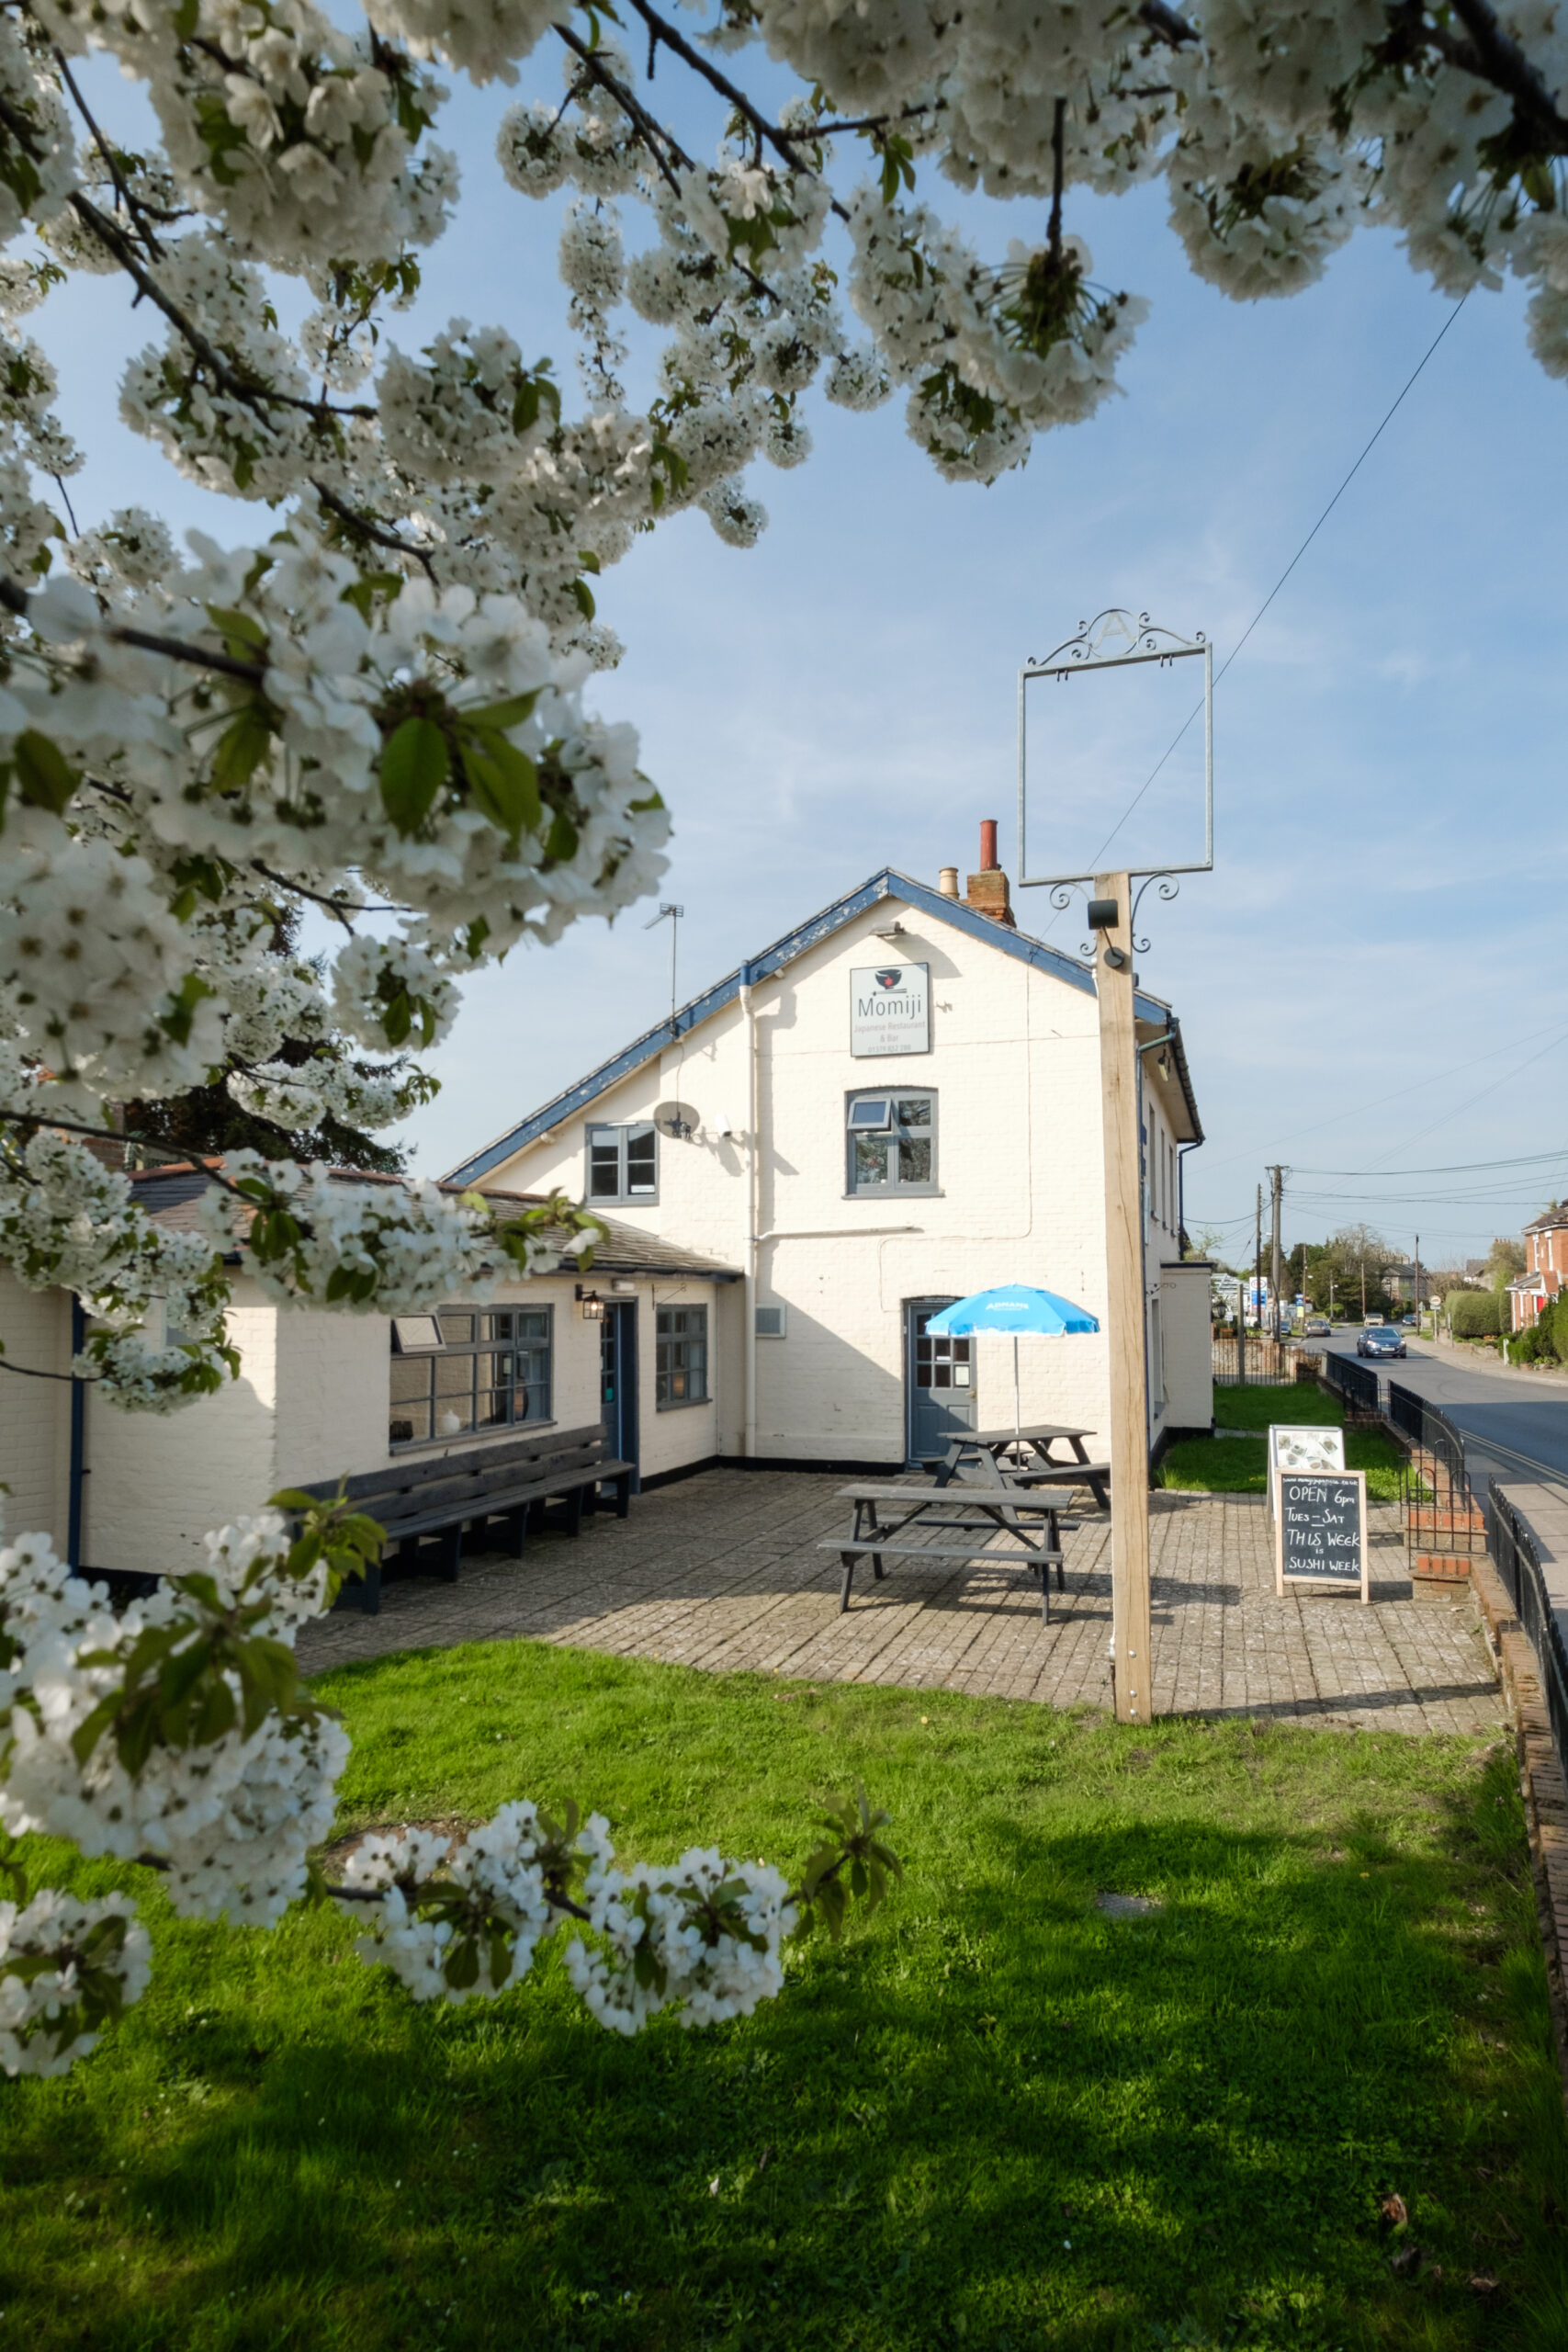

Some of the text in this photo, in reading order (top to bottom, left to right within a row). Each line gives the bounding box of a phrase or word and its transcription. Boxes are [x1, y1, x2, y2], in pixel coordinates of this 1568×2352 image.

[858, 994, 921, 1020] Momiji
[887, 1021, 926, 1030] Restaurant
[1289, 1486, 1355, 1507] OPEN 6pm
[1322, 1508, 1345, 1524] SAT
[1287, 1529, 1322, 1547] THIS
[1289, 1556, 1325, 1571] SUSHI
